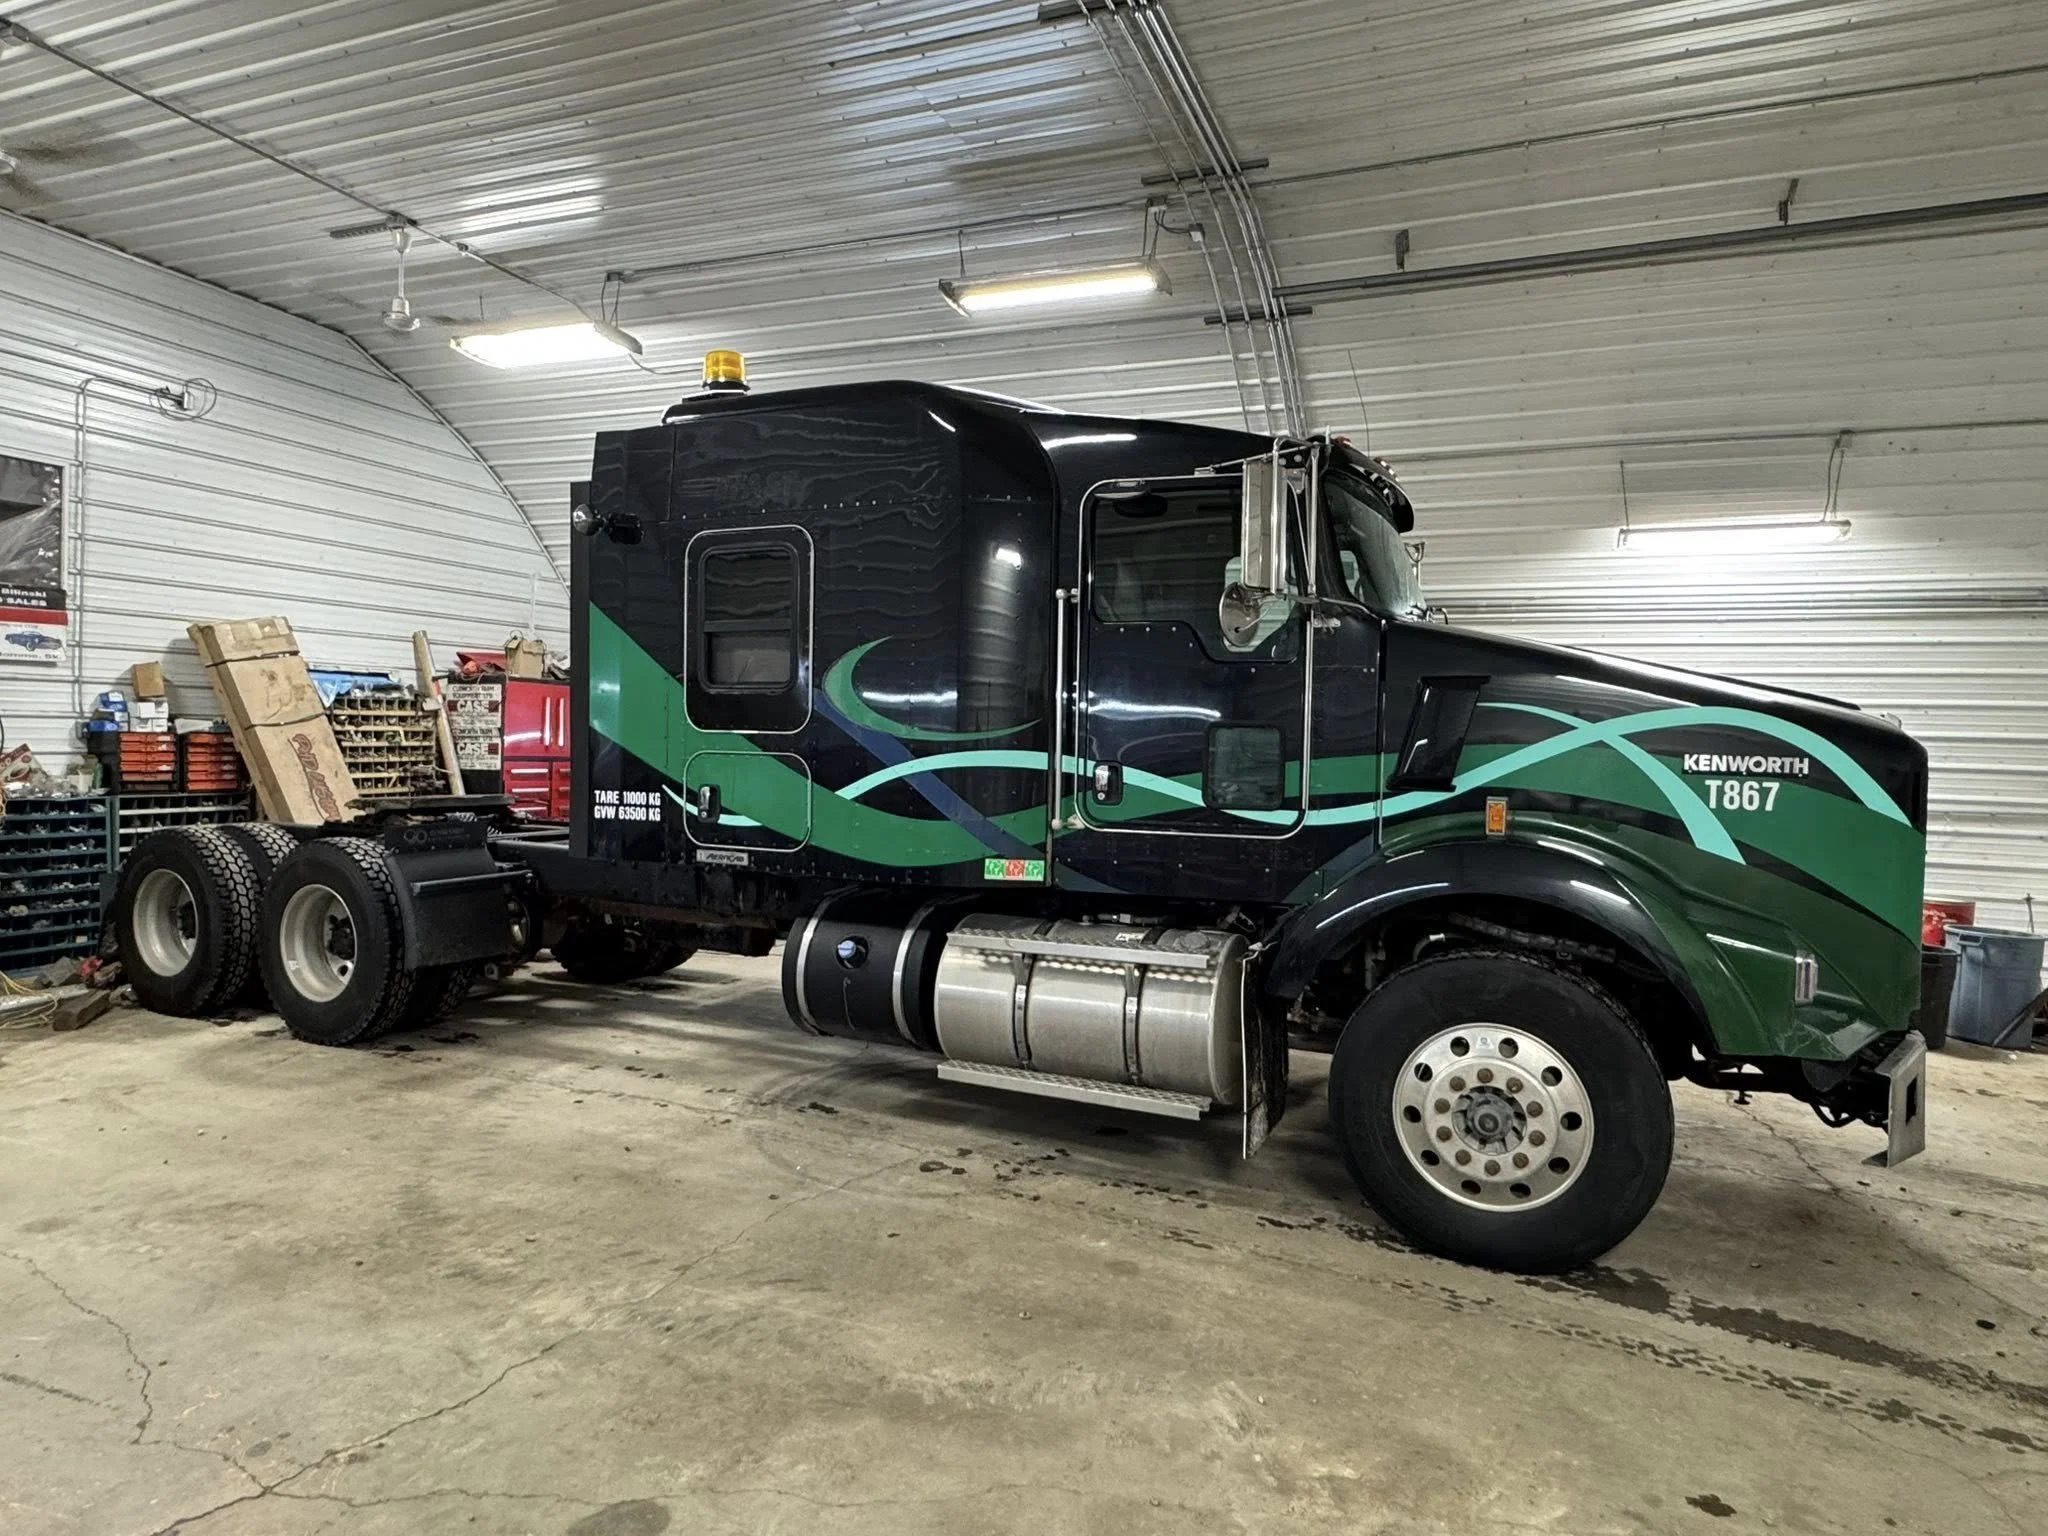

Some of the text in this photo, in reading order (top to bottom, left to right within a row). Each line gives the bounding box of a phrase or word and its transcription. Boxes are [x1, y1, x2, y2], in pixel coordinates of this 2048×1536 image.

[457, 700, 489, 712] CASE
[456, 743, 488, 755] CASE
[1683, 754, 1809, 775] KENWORTH
[594, 790, 661, 806] TARE 11000 KG
[1704, 780, 1780, 812] T867
[594, 805, 661, 822] GVW 63500 KG
